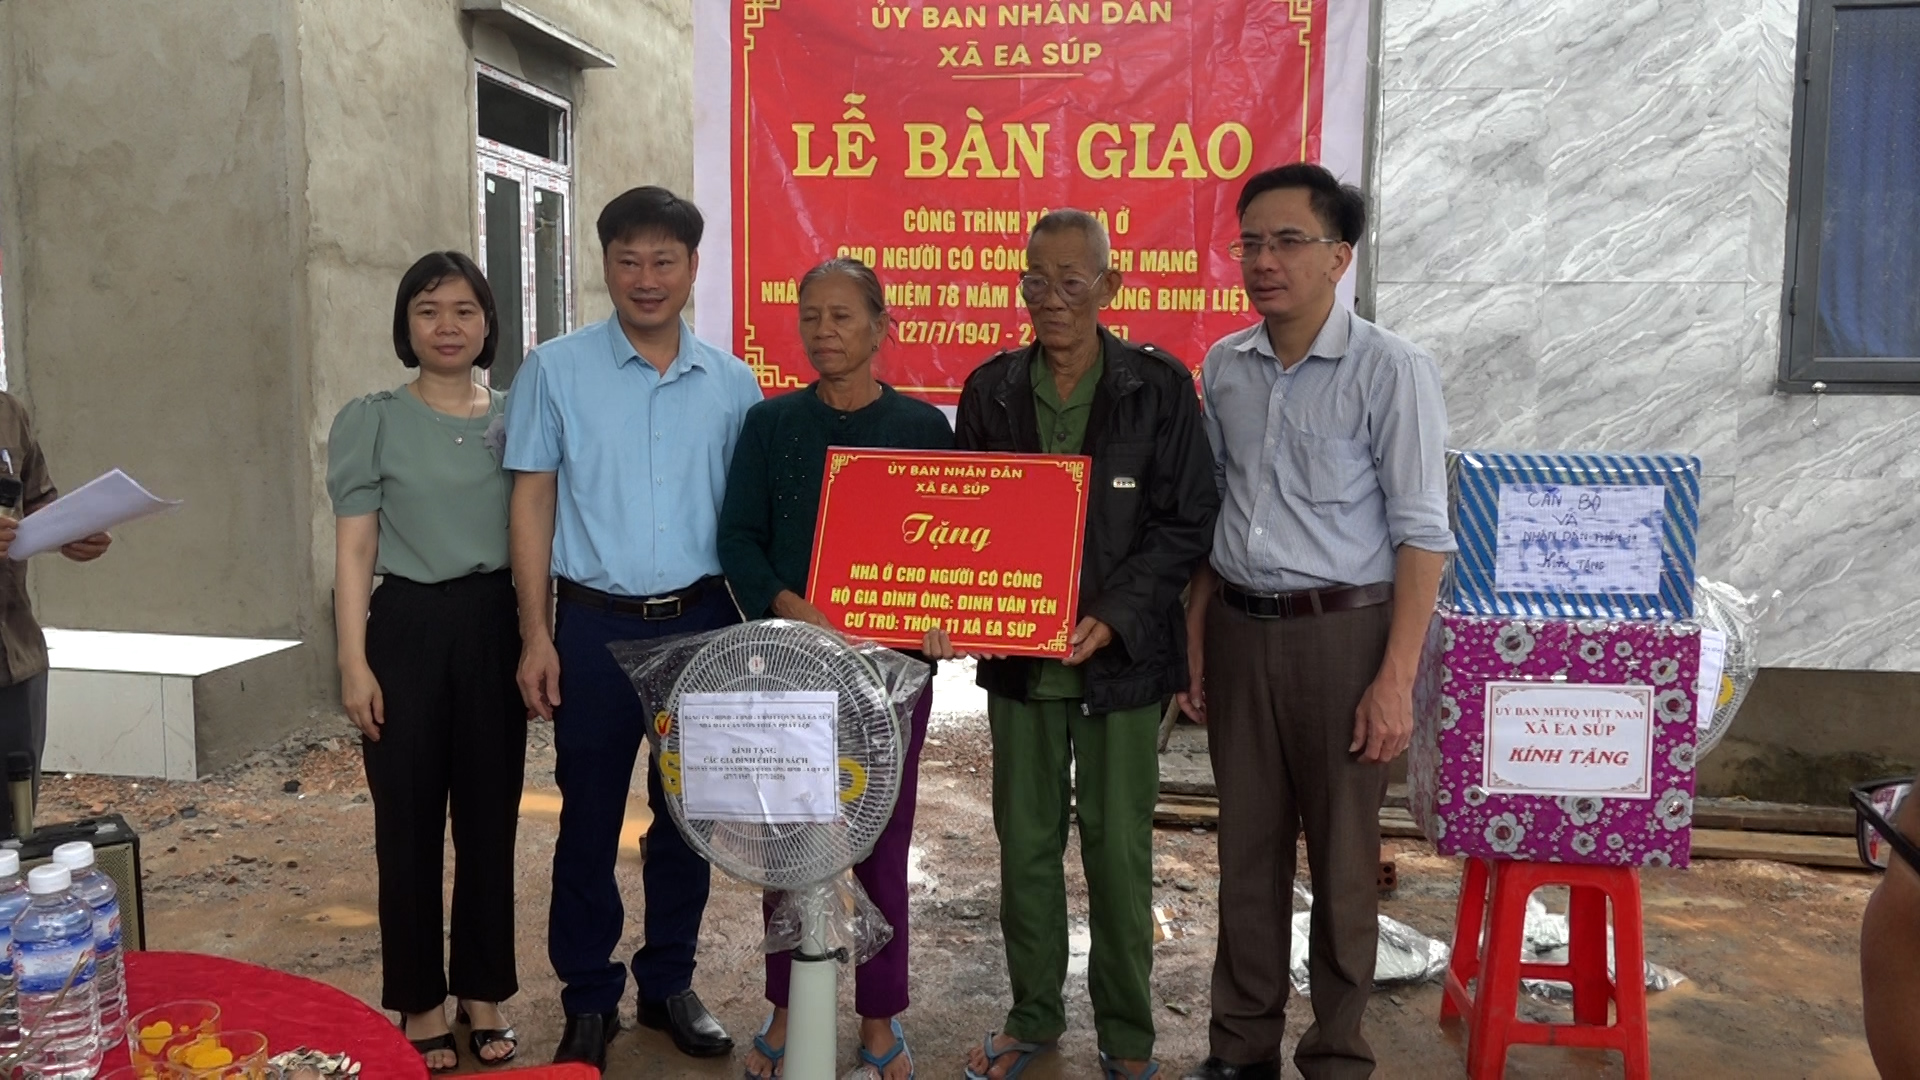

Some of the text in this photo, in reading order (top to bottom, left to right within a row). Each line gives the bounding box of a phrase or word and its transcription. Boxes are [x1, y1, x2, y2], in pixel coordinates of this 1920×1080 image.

[871, 0, 911, 28] ỦY
[922, 5, 986, 28] BAN
[938, 37, 1103, 67] XÃ EA SÚP
[792, 93, 1253, 180] LỄ BÀN GIAO
[903, 205, 956, 233] CÔNG
[962, 207, 1020, 234] TRÌNH
[1115, 205, 1131, 235] Ở
[883, 244, 942, 271] NGƯỜI
[948, 244, 974, 271] CÓ
[1107, 248, 1134, 272] CH
[1140, 249, 1198, 278] MẠNG
[761, 277, 800, 303] NHÂ
[885, 281, 931, 310] NIỆM
[937, 285, 960, 307] 78
[966, 282, 1009, 308] NĂM
[1157, 288, 1207, 311] BINH
[1212, 285, 1250, 316] LIỆT
[899, 321, 1000, 345] (27/7/1947
[888, 461, 1022, 478] ỦY BAN NHÂN DÂN
[915, 481, 990, 495] XÃ EA SÚP
[902, 513, 992, 552] Tặng
[850, 562, 1043, 589] NHÀ Ở CHO NGƯỜI CÓ CÔNG
[831, 585, 851, 606] HỘ
[853, 589, 878, 606] GIA
[881, 590, 917, 608] ĐÌNH
[920, 590, 955, 610] ÔNG:
[997, 595, 1027, 614] VĂN
[844, 611, 1037, 638] CƯ TRÚ: THÔN 11 XÃ EA SÚP
[1515, 707, 1540, 717] BAN
[1543, 707, 1580, 719] MTTQ
[1582, 708, 1612, 723] VIỆT
[1615, 710, 1643, 720] NAM
[1524, 719, 1616, 736] XÃ EA SÚP
[1508, 746, 1629, 767] KÍNH TẶNG
